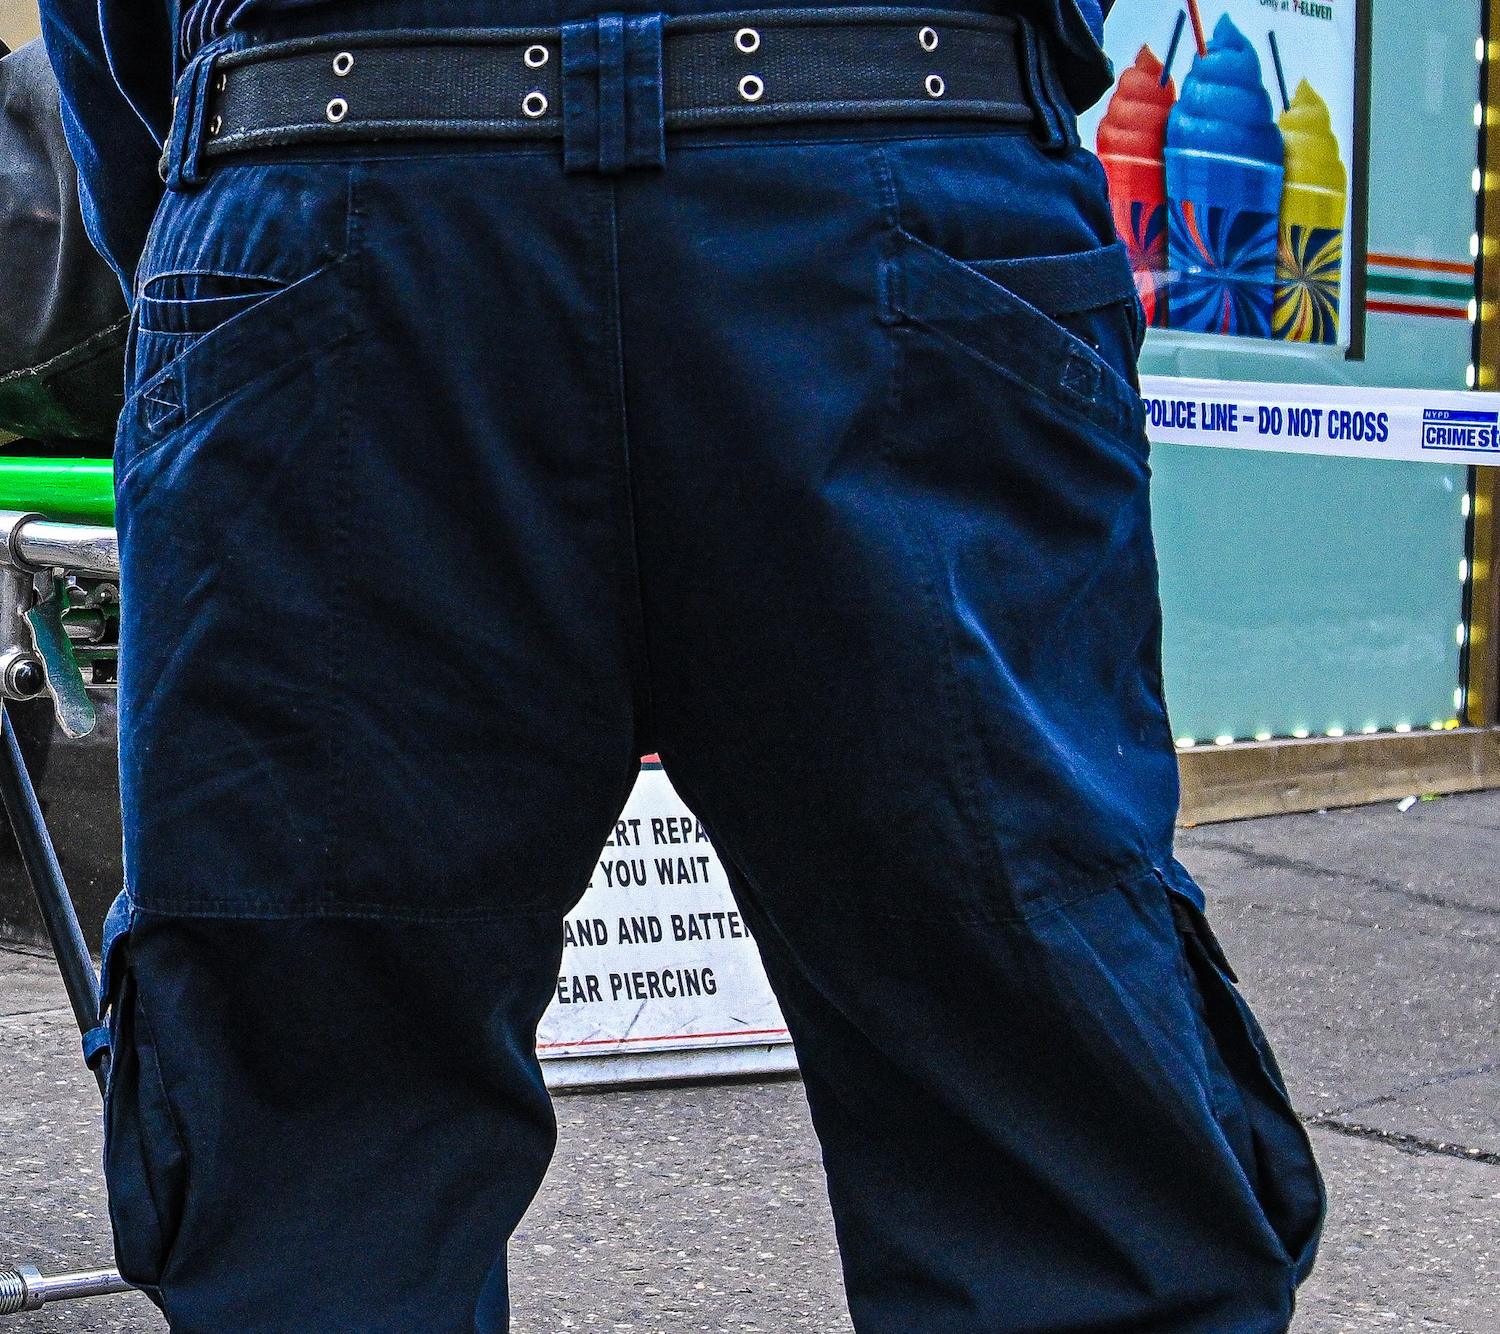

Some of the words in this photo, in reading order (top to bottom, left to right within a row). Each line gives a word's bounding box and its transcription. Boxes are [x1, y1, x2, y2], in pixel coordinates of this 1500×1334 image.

[1281, 0, 1290, 11] at
[1142, 399, 1196, 430] POLICE
[1201, 402, 1238, 433] LINE
[1258, 406, 1282, 436] DO
[1287, 408, 1322, 438] NOT
[1327, 411, 1389, 443] CROSS
[1423, 410, 1451, 419] NYPD
[600, 859, 648, 888] YOU
[654, 856, 710, 886] WAIT
[618, 916, 663, 945] AND
[670, 912, 750, 942] BATTE
[609, 967, 718, 1001] PIERCING
